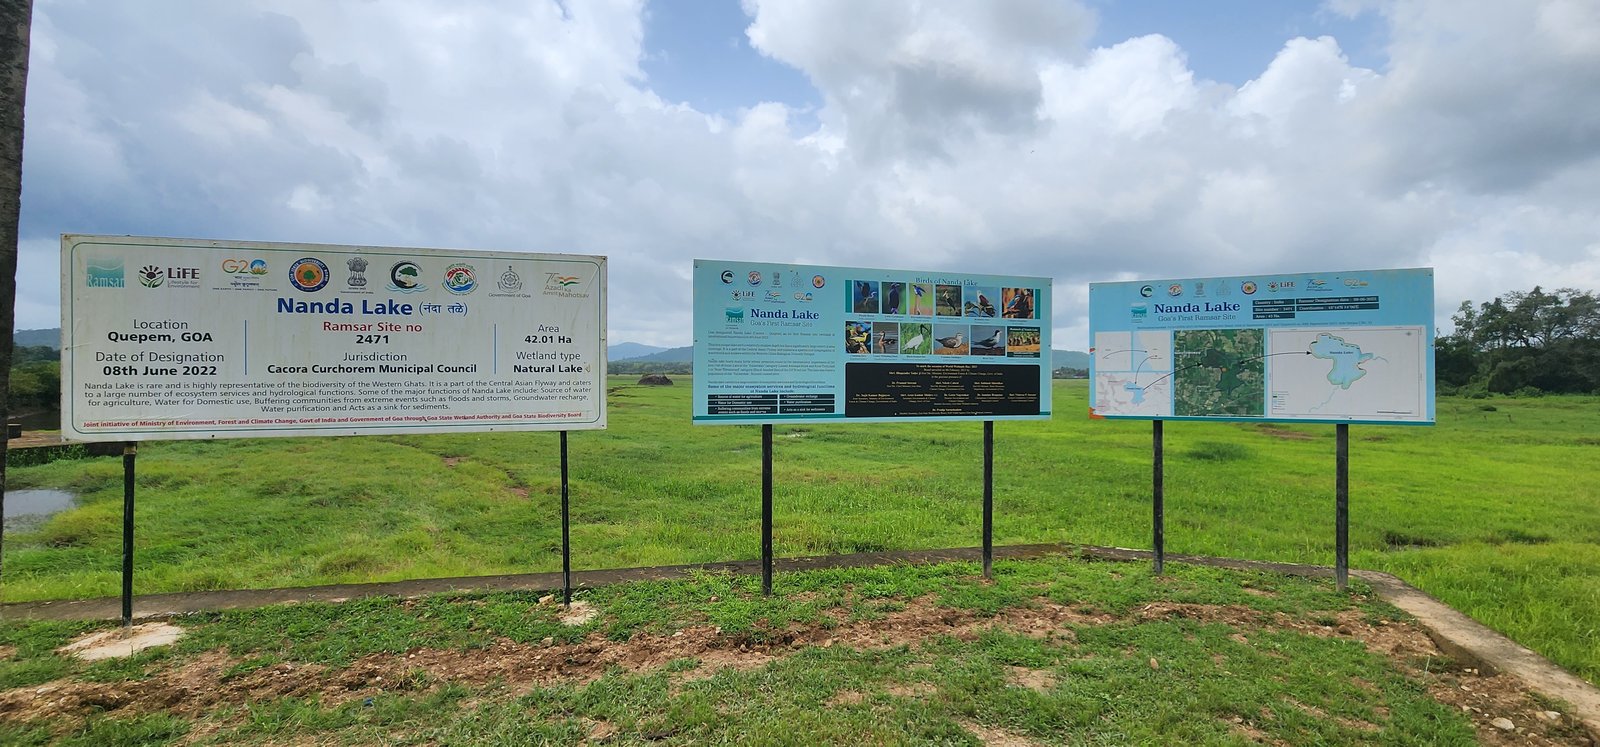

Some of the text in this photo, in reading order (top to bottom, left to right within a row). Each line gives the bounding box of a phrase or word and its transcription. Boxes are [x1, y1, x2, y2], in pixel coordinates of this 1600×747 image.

[168, 267, 200, 279] LiFE
[88, 274, 125, 288] Ramsar
[277, 297, 413, 315] Nanda Lake
[1154, 302, 1240, 313] Nanda Lake
[751, 309, 819, 319] Nanda Lake
[133, 319, 188, 329] Location
[323, 321, 373, 331] Ramsar
[377, 322, 401, 332] Site
[537, 324, 559, 333] Area
[108, 332, 213, 344] Quepem, GOA
[356, 335, 389, 344] 2471
[525, 335, 553, 343] 42.01
[96, 351, 224, 364] Date of Designation
[343, 352, 407, 362] Jurisdiction
[516, 351, 581, 362] Wetland type
[103, 366, 217, 376] 08th June 2022
[268, 364, 476, 375] Cacora Curchorem Municipal Council
[513, 364, 582, 373] Natural Lake
[192, 382, 217, 390] highly
[220, 382, 275, 390] representative
[104, 391, 126, 399] large
[103, 399, 152, 407] agriculture,
